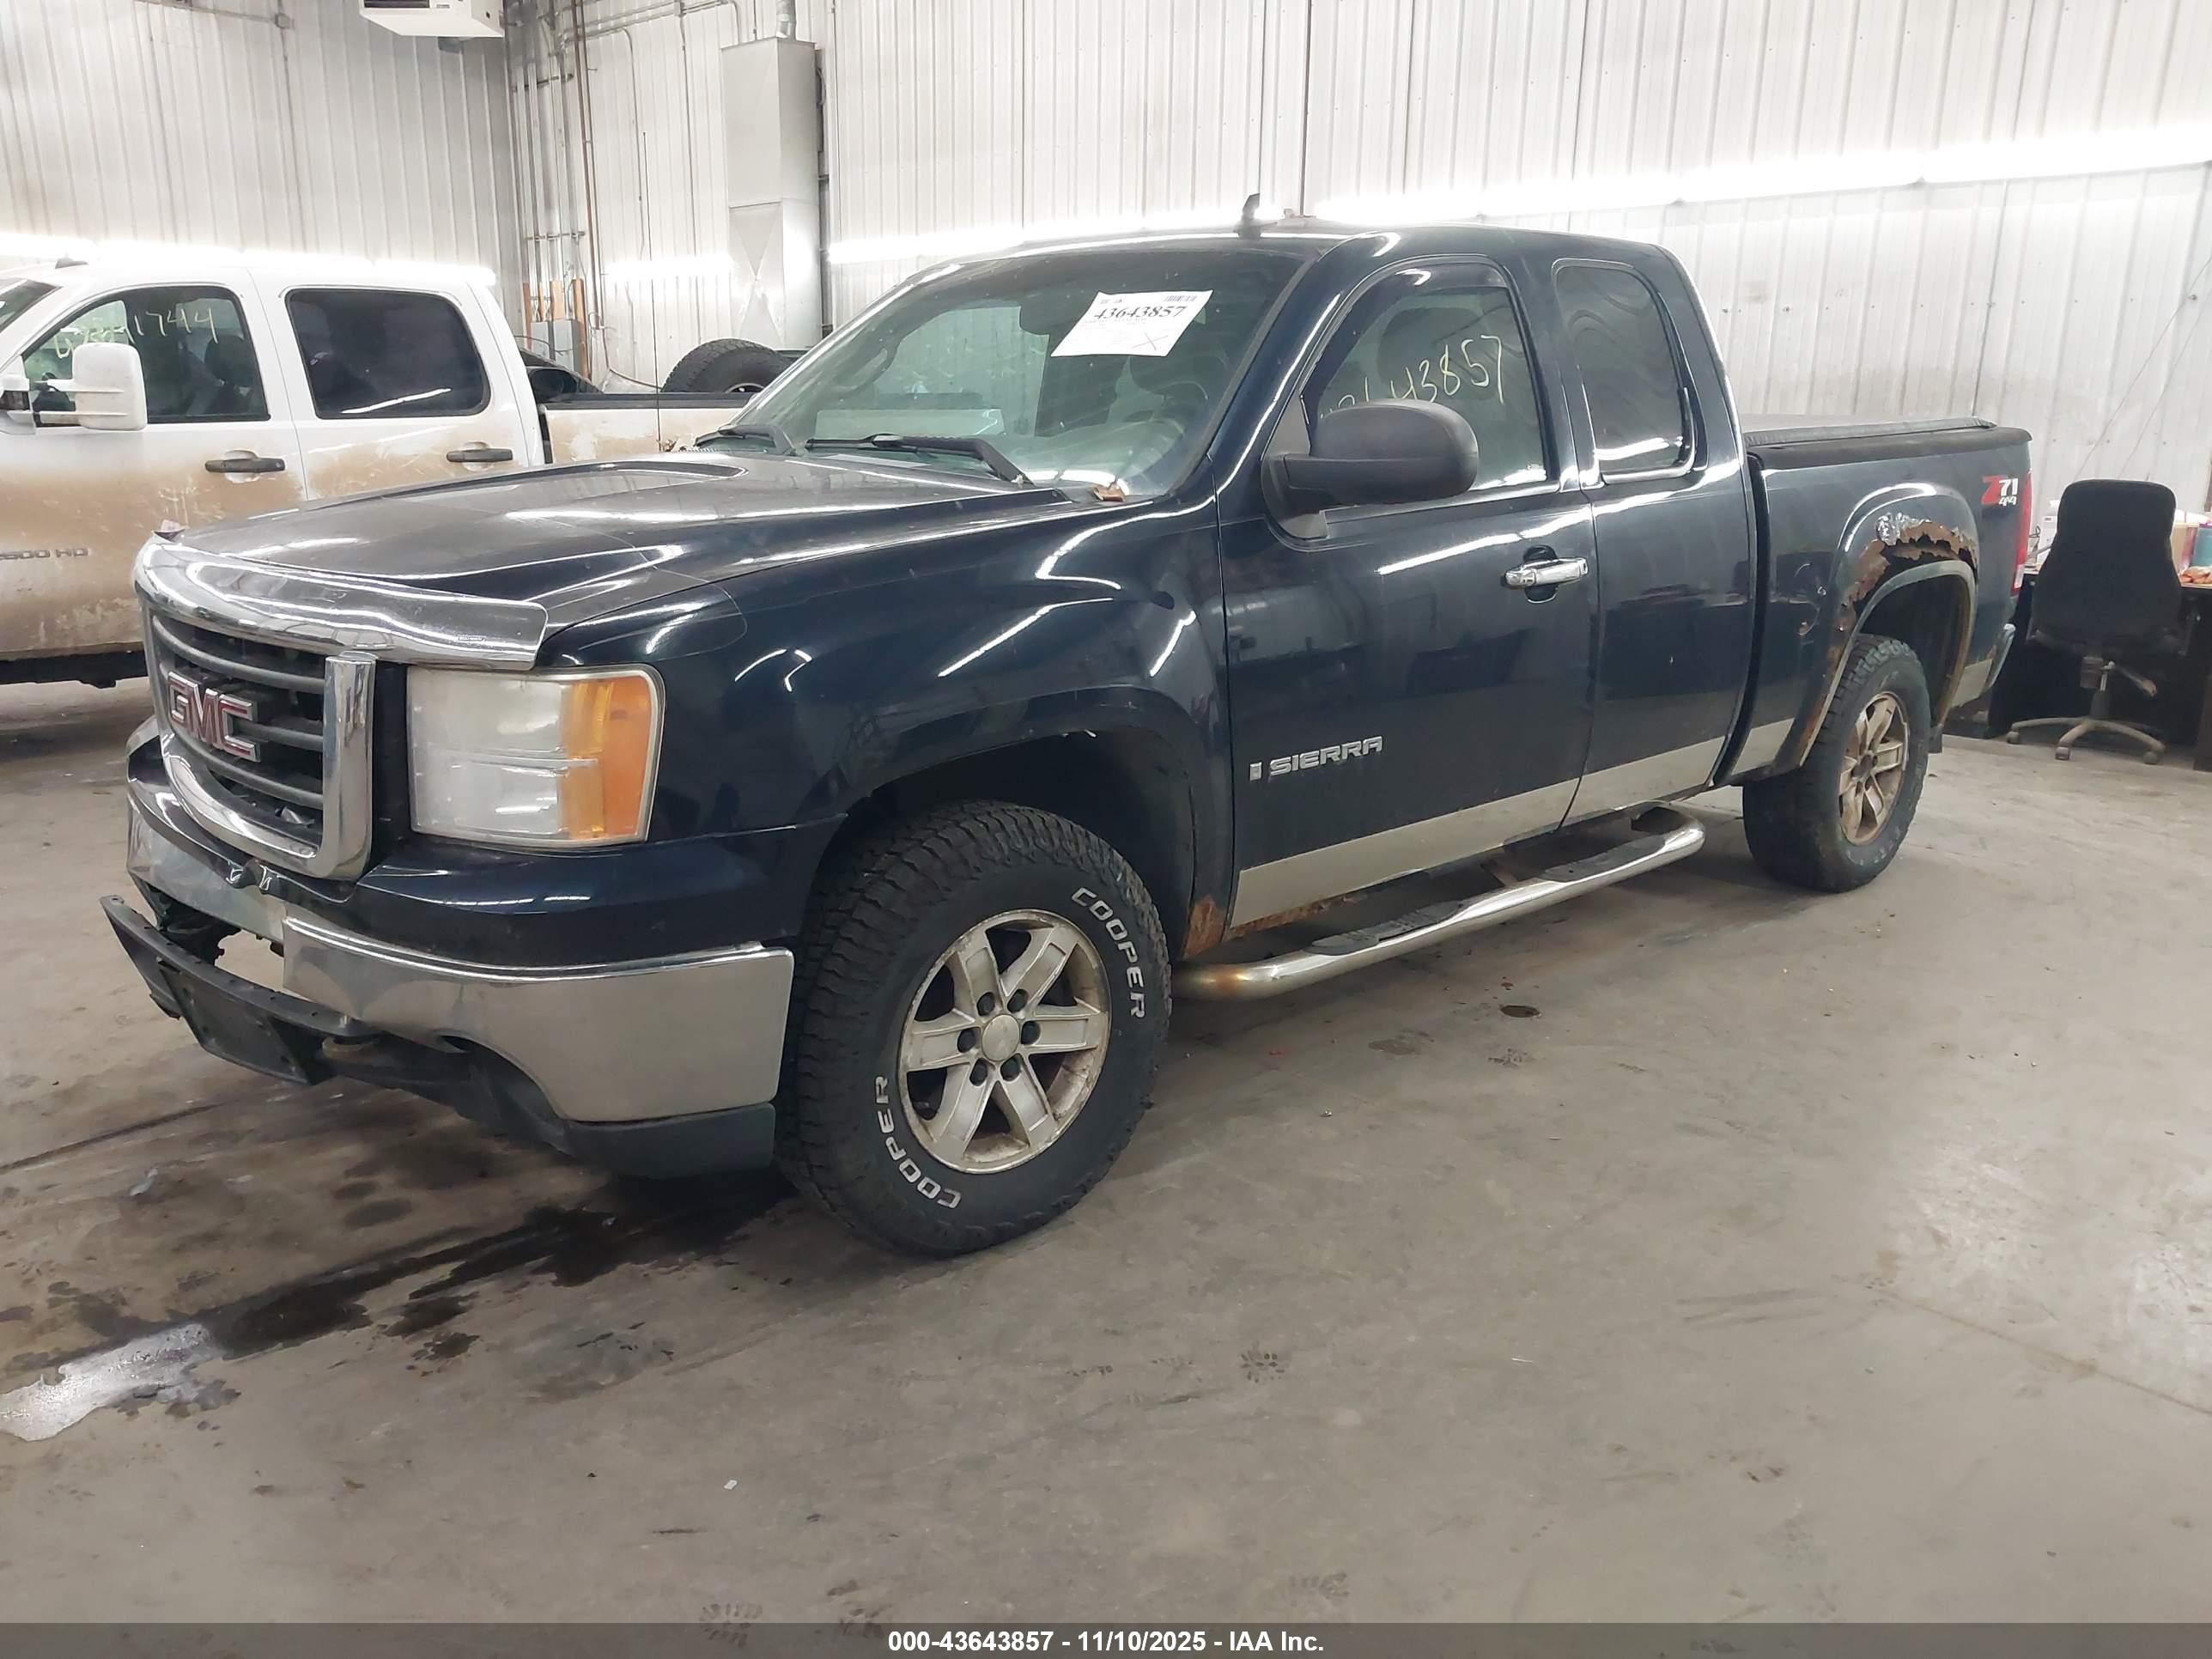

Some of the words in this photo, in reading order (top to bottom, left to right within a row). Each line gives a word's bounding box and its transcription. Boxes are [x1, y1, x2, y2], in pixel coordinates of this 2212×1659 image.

[1093, 306, 1188, 319] 43643857
[1981, 475, 2019, 505] Z71
[0, 550, 52, 561] 500
[55, 548, 89, 558] HD
[167, 671, 261, 763] GMC
[1269, 735, 1383, 777] SIERRA
[1071, 886, 1147, 1019] COOPER
[874, 1075, 963, 1210] COOPER
